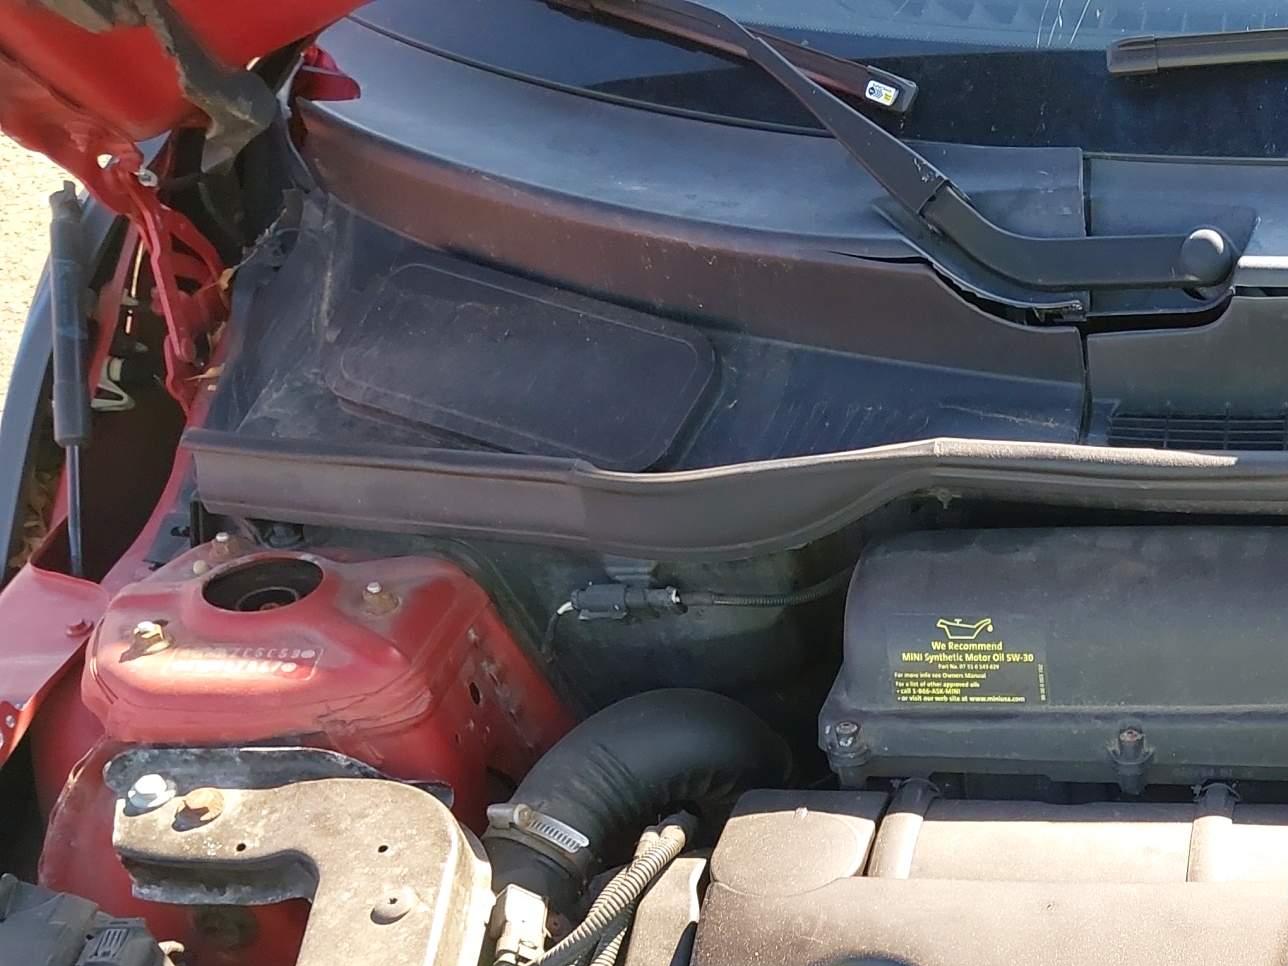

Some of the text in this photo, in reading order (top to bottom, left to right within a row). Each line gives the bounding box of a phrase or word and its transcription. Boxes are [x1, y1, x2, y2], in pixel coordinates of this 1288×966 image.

[931, 641, 1003, 650] We Recommend
[902, 652, 1034, 663] MINI Synthetic Motor Oil 5W-30
